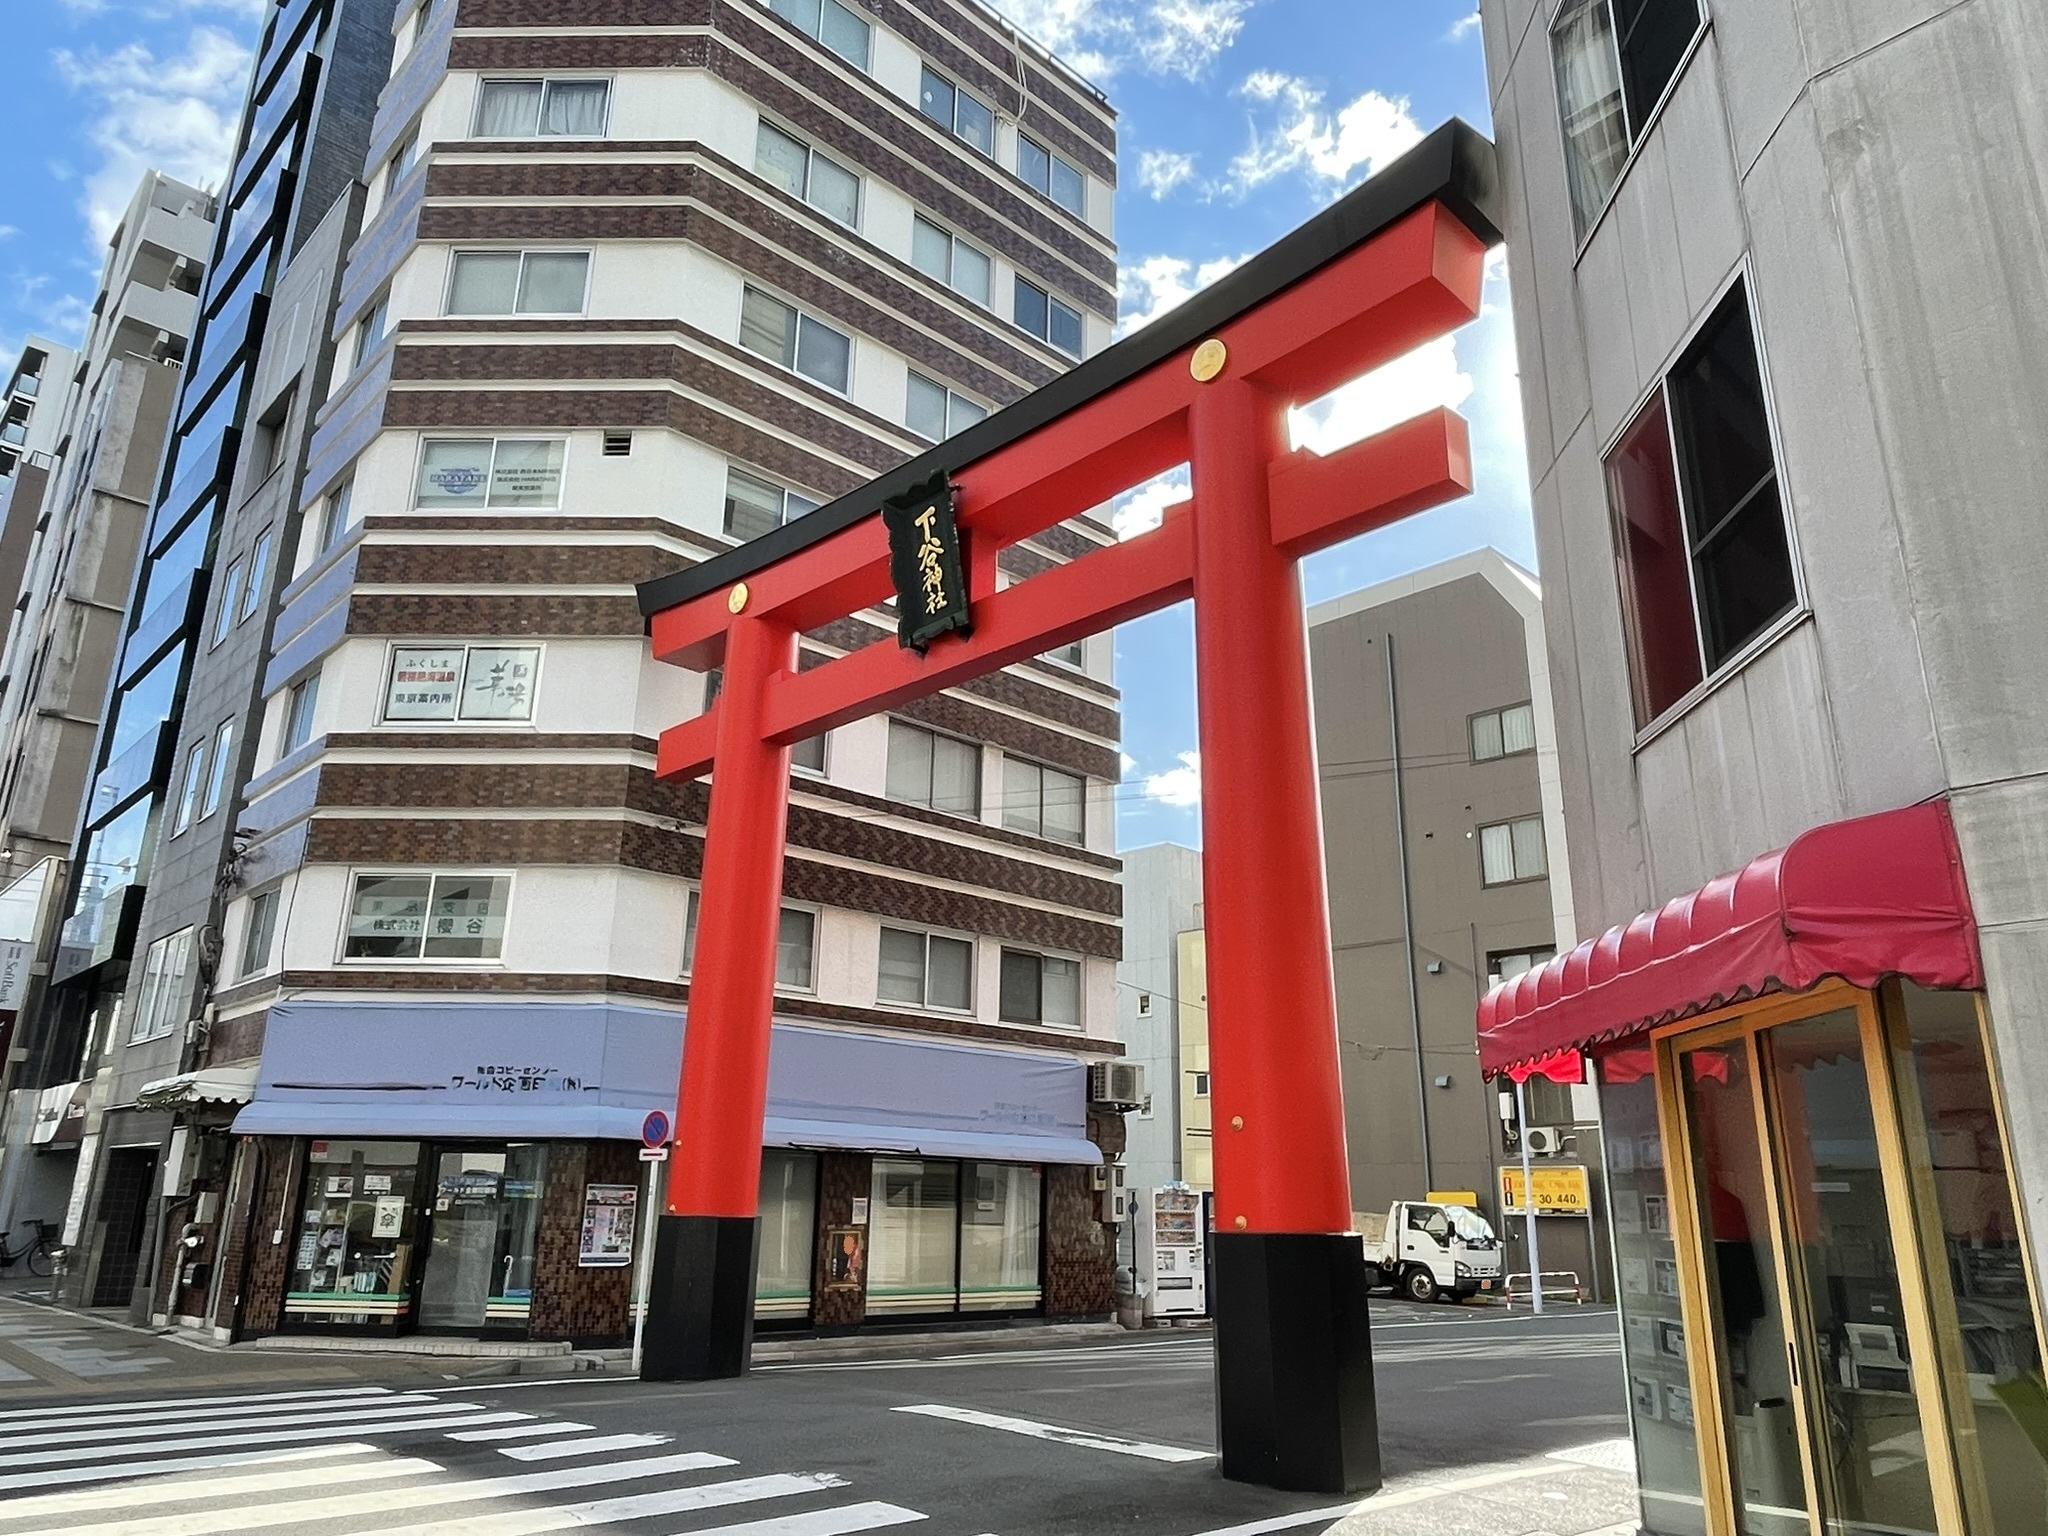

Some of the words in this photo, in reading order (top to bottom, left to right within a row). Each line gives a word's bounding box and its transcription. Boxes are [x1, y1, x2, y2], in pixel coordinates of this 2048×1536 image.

[914, 505, 948, 615] 下谷神社
[406, 659, 450, 668] ふくしま
[395, 693, 453, 704] 東京案内所
